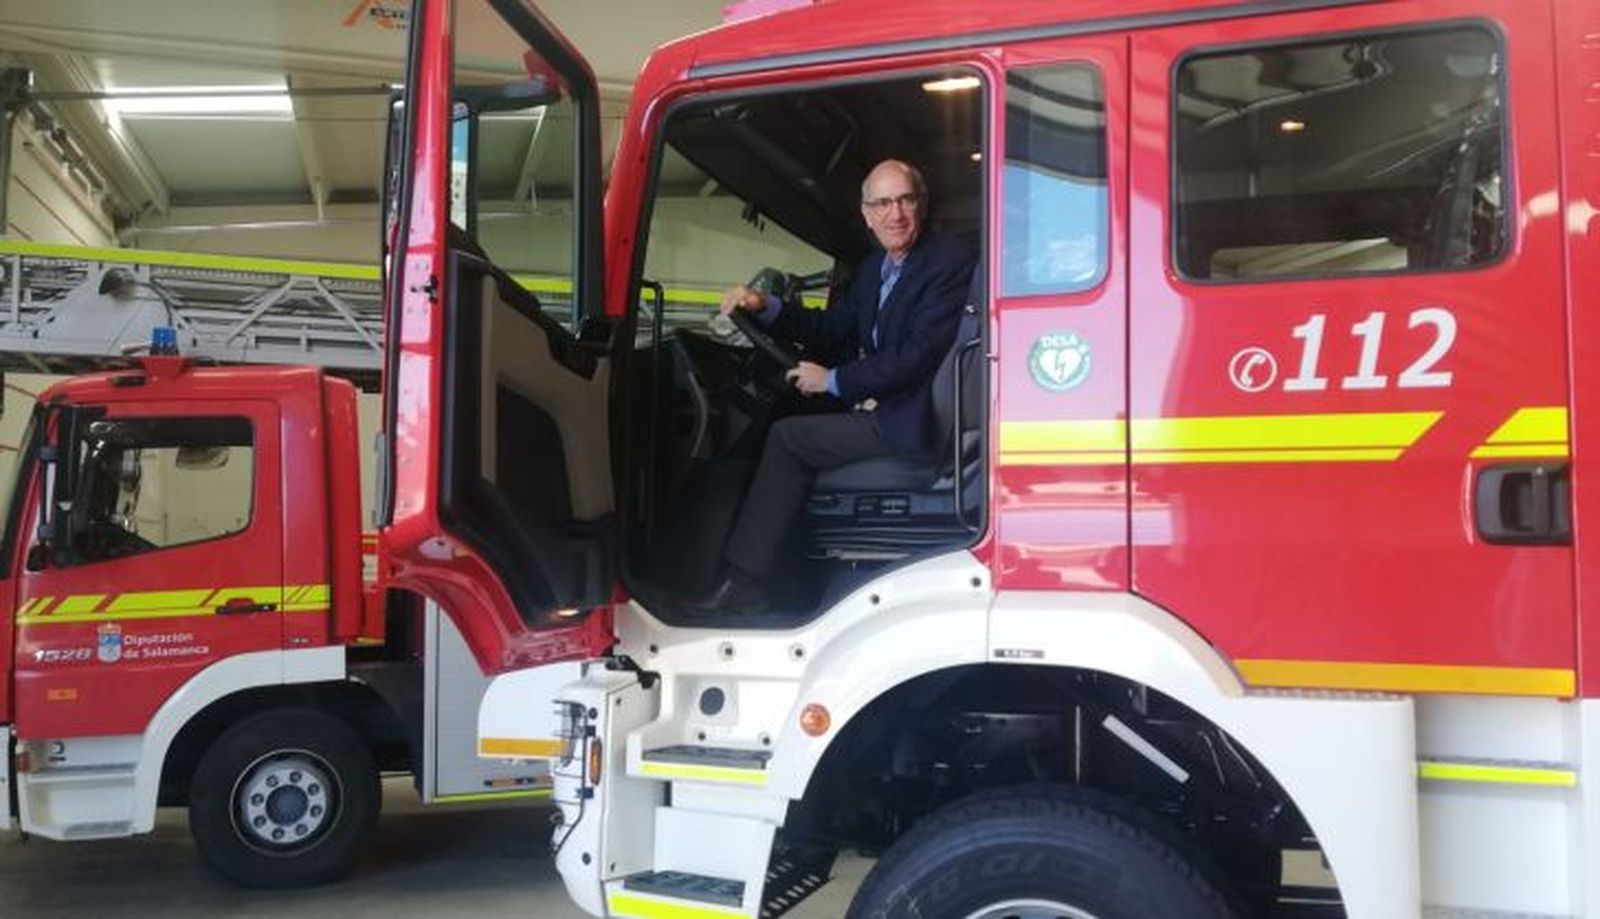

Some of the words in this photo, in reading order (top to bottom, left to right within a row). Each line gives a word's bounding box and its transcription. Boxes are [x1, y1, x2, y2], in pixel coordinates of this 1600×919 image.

[1282, 307, 1457, 391] 112
[123, 632, 194, 646] Diputación
[34, 648, 92, 661] 1528
[123, 649, 140, 659] de
[143, 645, 209, 658] Salamanca
